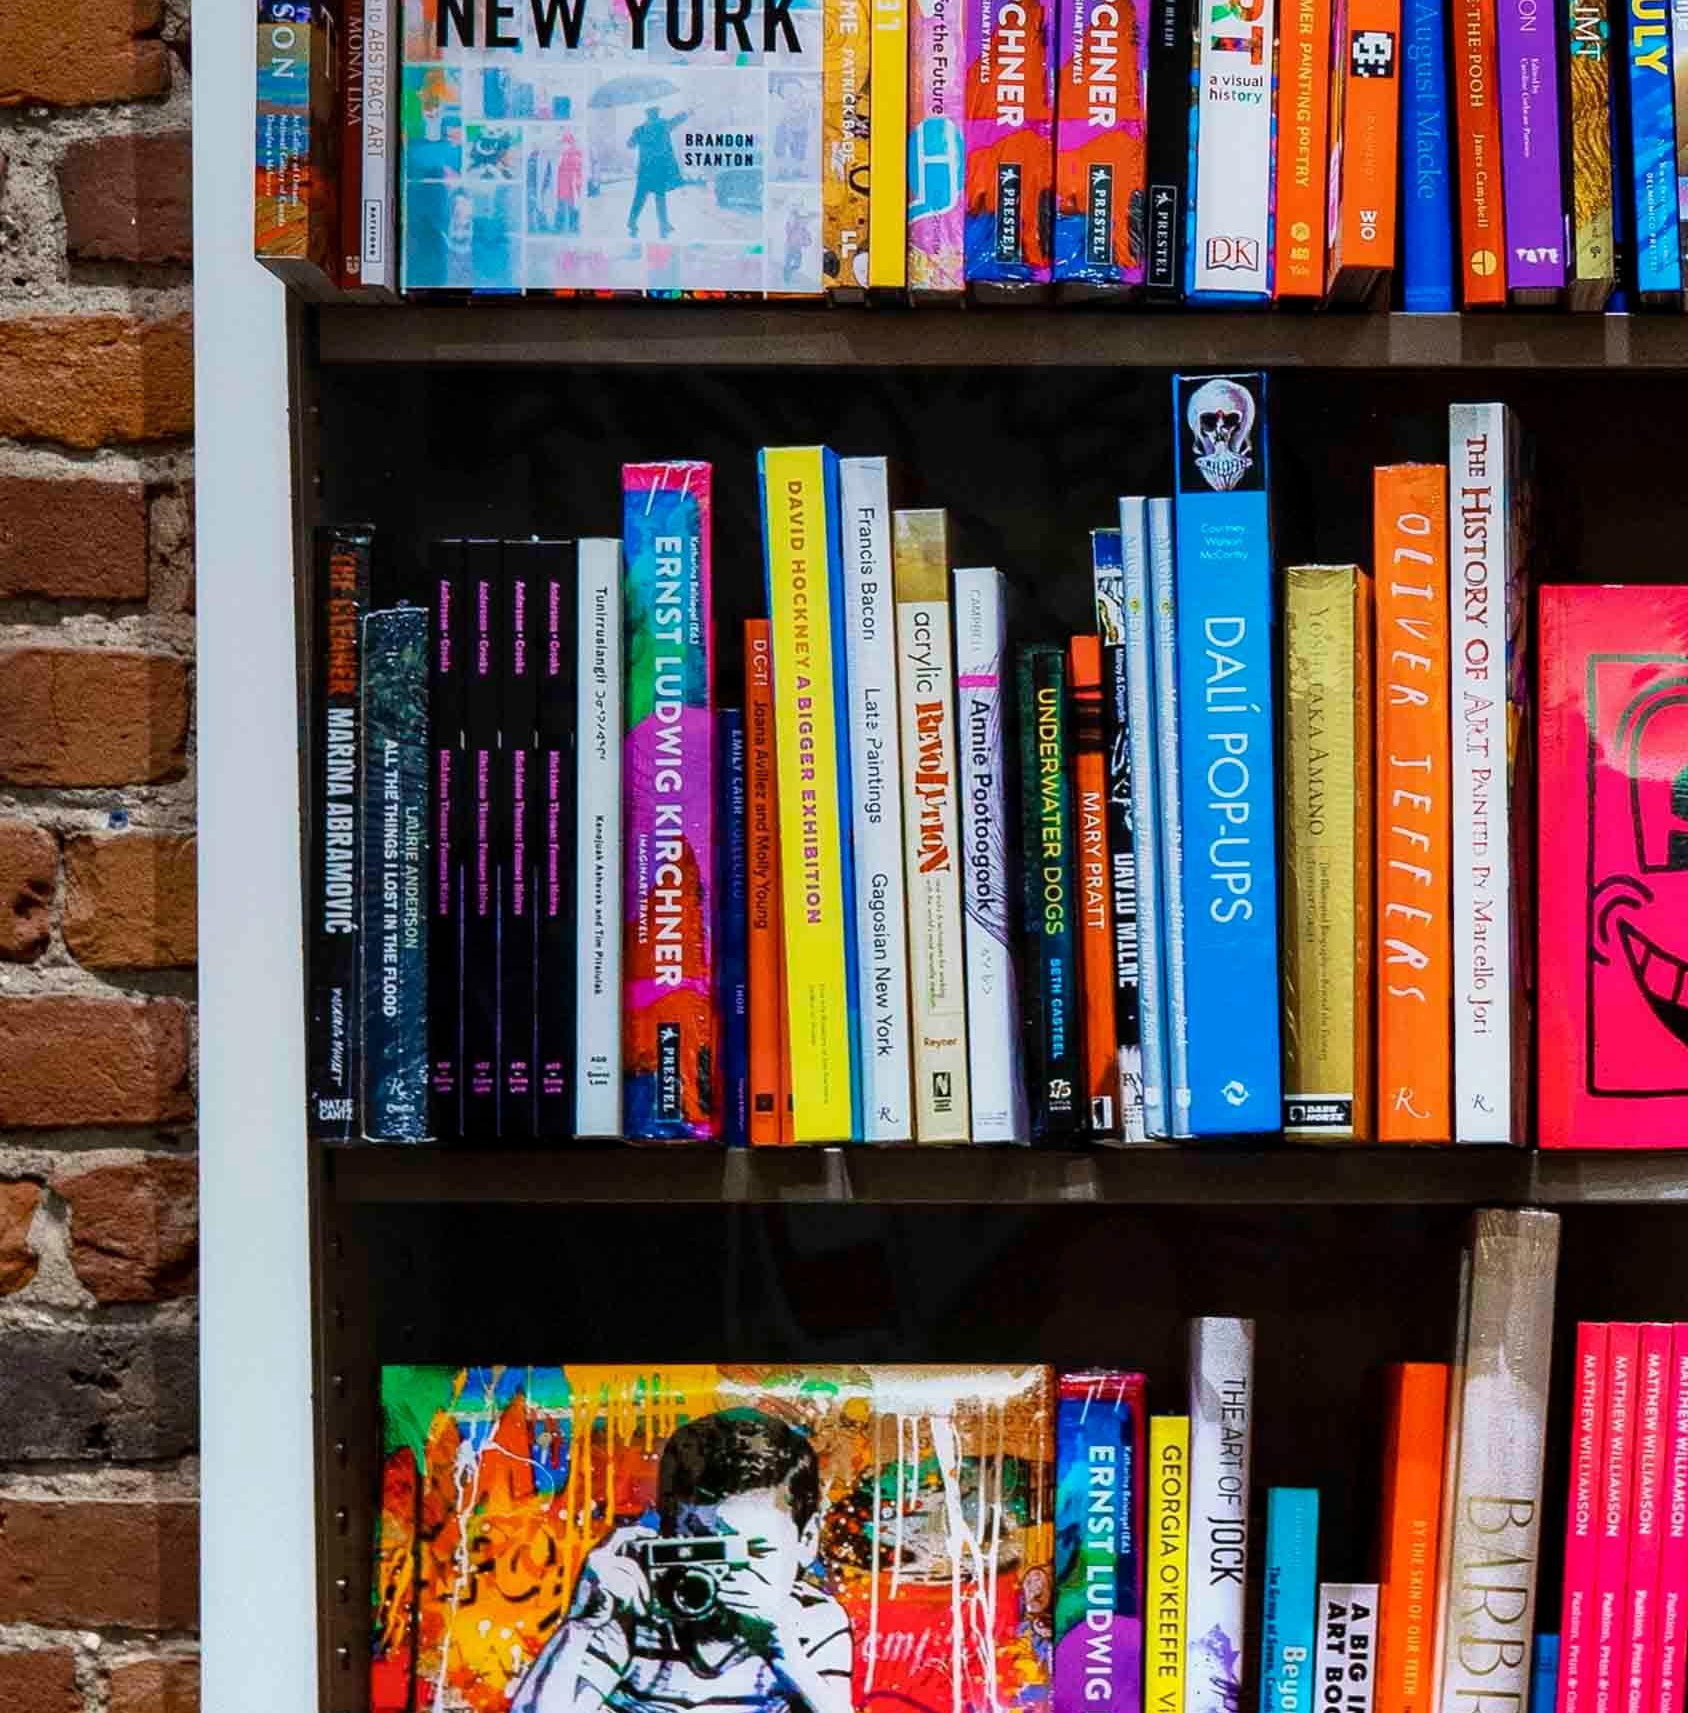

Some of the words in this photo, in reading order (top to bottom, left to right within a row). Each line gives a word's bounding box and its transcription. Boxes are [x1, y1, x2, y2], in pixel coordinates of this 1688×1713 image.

[1208, 89, 1264, 104] history
[1219, 73, 1264, 89] visual
[684, 153, 755, 168] STANTON
[685, 133, 755, 148] BRANDON
[787, 479, 805, 552] DAVID
[791, 558, 811, 670] HOCKNEY
[1389, 513, 1434, 706] OLIVER
[795, 675, 811, 690] A
[1204, 617, 1262, 715] DALÍ
[326, 708, 354, 796] MARINA
[796, 696, 815, 782] BIGGER
[1038, 688, 1061, 858] UNDERWATER
[801, 789, 822, 926] EXHIBITION
[1206, 733, 1253, 923] POP-UPS
[324, 802, 358, 934] ABRAMOVIĆ
[1044, 866, 1064, 935] DOGS
[1385, 754, 1432, 1003] JEFFERS
[1327, 1601, 1346, 1654] ART
[1351, 1601, 1369, 1621] A
[1349, 1634, 1368, 1682] BIG
